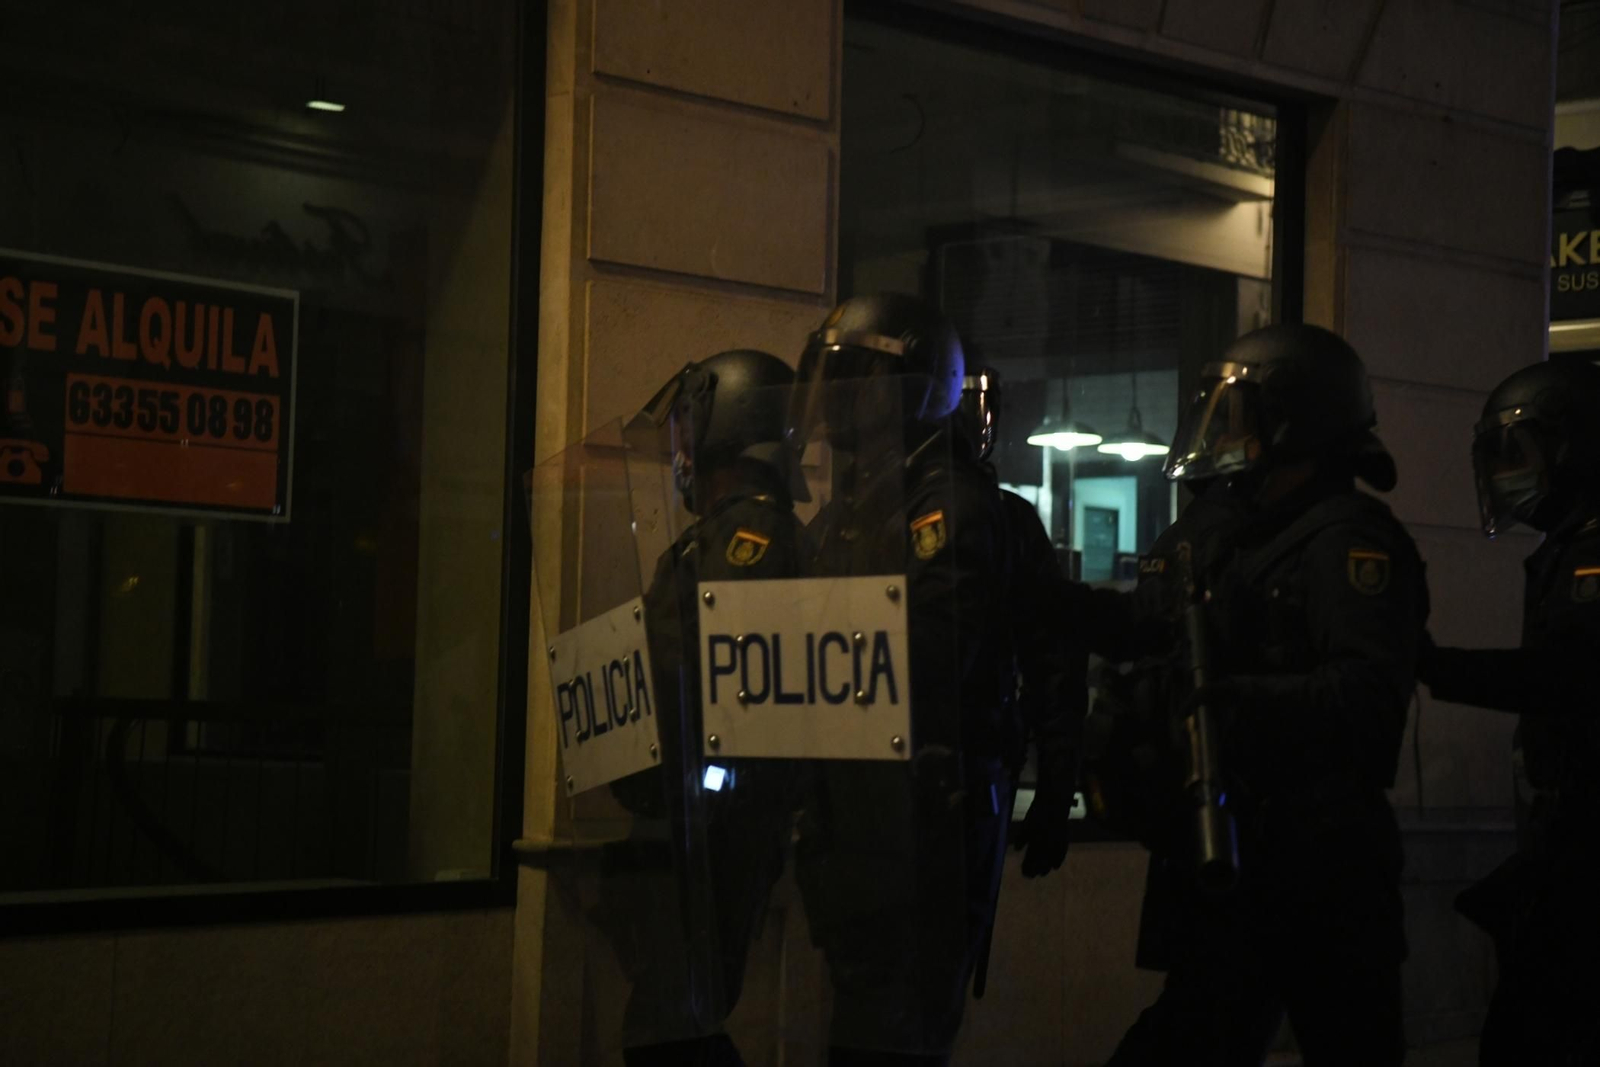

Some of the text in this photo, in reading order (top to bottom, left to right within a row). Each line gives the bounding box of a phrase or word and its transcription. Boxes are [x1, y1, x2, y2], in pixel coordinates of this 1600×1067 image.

[0, 275, 280, 378] SE ALQUILA
[557, 649, 651, 749] POLICIA
[708, 630, 898, 705] POLICIA
